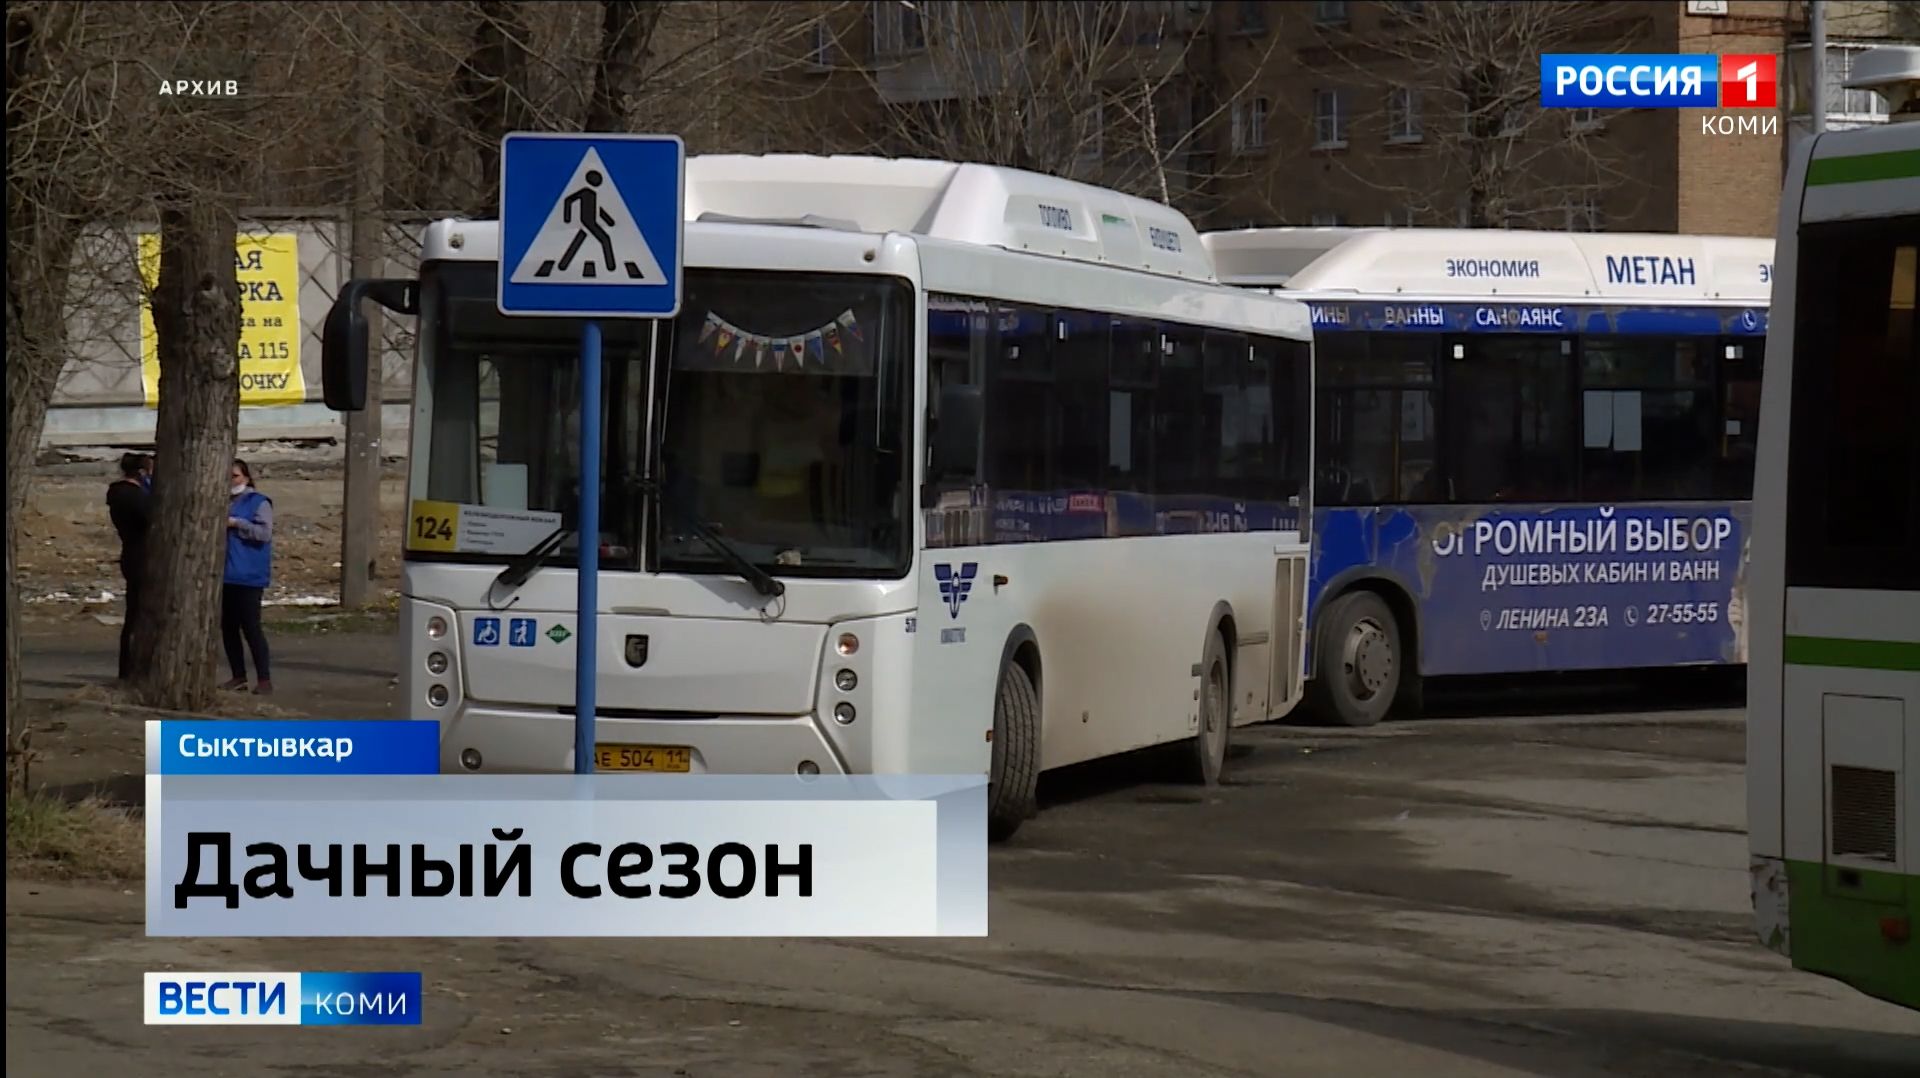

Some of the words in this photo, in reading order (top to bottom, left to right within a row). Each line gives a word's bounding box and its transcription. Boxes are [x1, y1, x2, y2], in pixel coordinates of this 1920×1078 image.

[235, 250, 263, 271] АЯ
[1446, 260, 1539, 277] ЭКОНОМИЯ
[1606, 255, 1695, 285] МЕТАН
[1758, 264, 1774, 282] Э
[239, 281, 283, 302] РКА
[1311, 307, 1349, 324] ИНЫ
[1384, 308, 1444, 325] ВАННЫ
[240, 343, 252, 360] А
[259, 342, 289, 360] 115
[241, 374, 290, 391] ОЧКУ
[415, 516, 453, 541] 124
[1433, 507, 1617, 555] ОГРОМНЫЙ
[1625, 518, 1731, 552] ВЫБОР
[1482, 563, 1580, 591] ДУШЕВЫХ
[1584, 563, 1648, 583] КАБИН
[1653, 562, 1665, 581] И
[1670, 560, 1720, 580] ВАНН
[1496, 608, 1569, 630] ЛЕНИНА
[1574, 607, 1609, 627] 23А
[1647, 603, 1718, 623] 27-55-55
[620, 750, 654, 767] 504
[666, 750, 683, 763] 11
